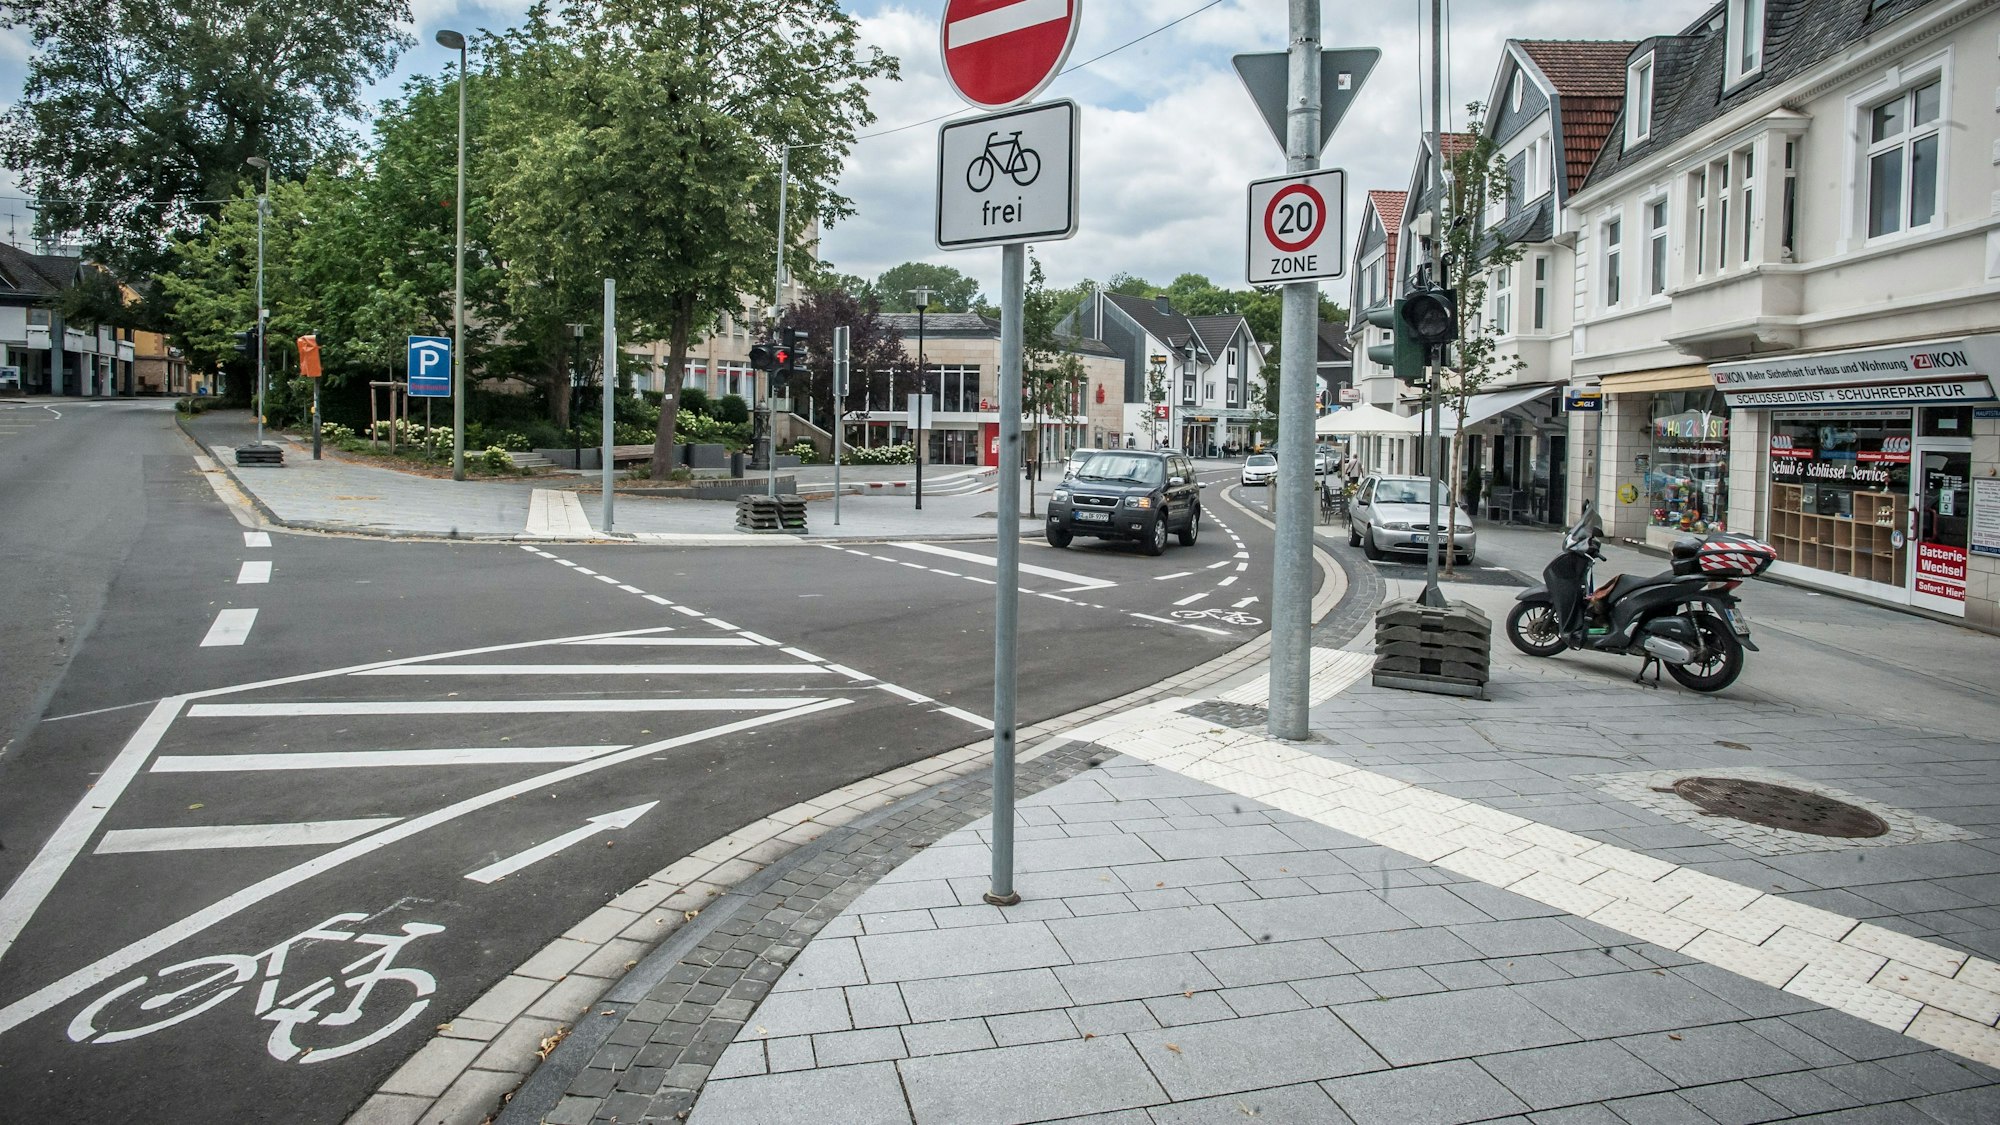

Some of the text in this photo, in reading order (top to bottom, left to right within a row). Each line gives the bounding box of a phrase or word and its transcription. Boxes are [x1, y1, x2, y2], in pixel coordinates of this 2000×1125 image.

[982, 196, 1023, 226] frei
[1278, 200, 1313, 236] 20
[1270, 254, 1318, 275] ZONE
[419, 349, 440, 376] P
[1746, 371, 1766, 381] Mehr
[1767, 368, 1804, 380] Sicherheit
[1804, 366, 1817, 377] für
[1818, 365, 1839, 376] Haus
[1840, 363, 1858, 374] und
[1858, 360, 1909, 372] Wohnung
[1736, 384, 1966, 404] SCHLÜSSELDIENST + SCHUHREPARATUR
[1796, 462, 1804, 475] &
[1806, 462, 1847, 479] Schlüssel
[1852, 465, 1887, 482] Service
[1920, 544, 1966, 563] Batterie-
[1921, 559, 1963, 578] Wechsel
[1918, 580, 1944, 594] Sofort!
[1945, 586, 1965, 599] Hier!
